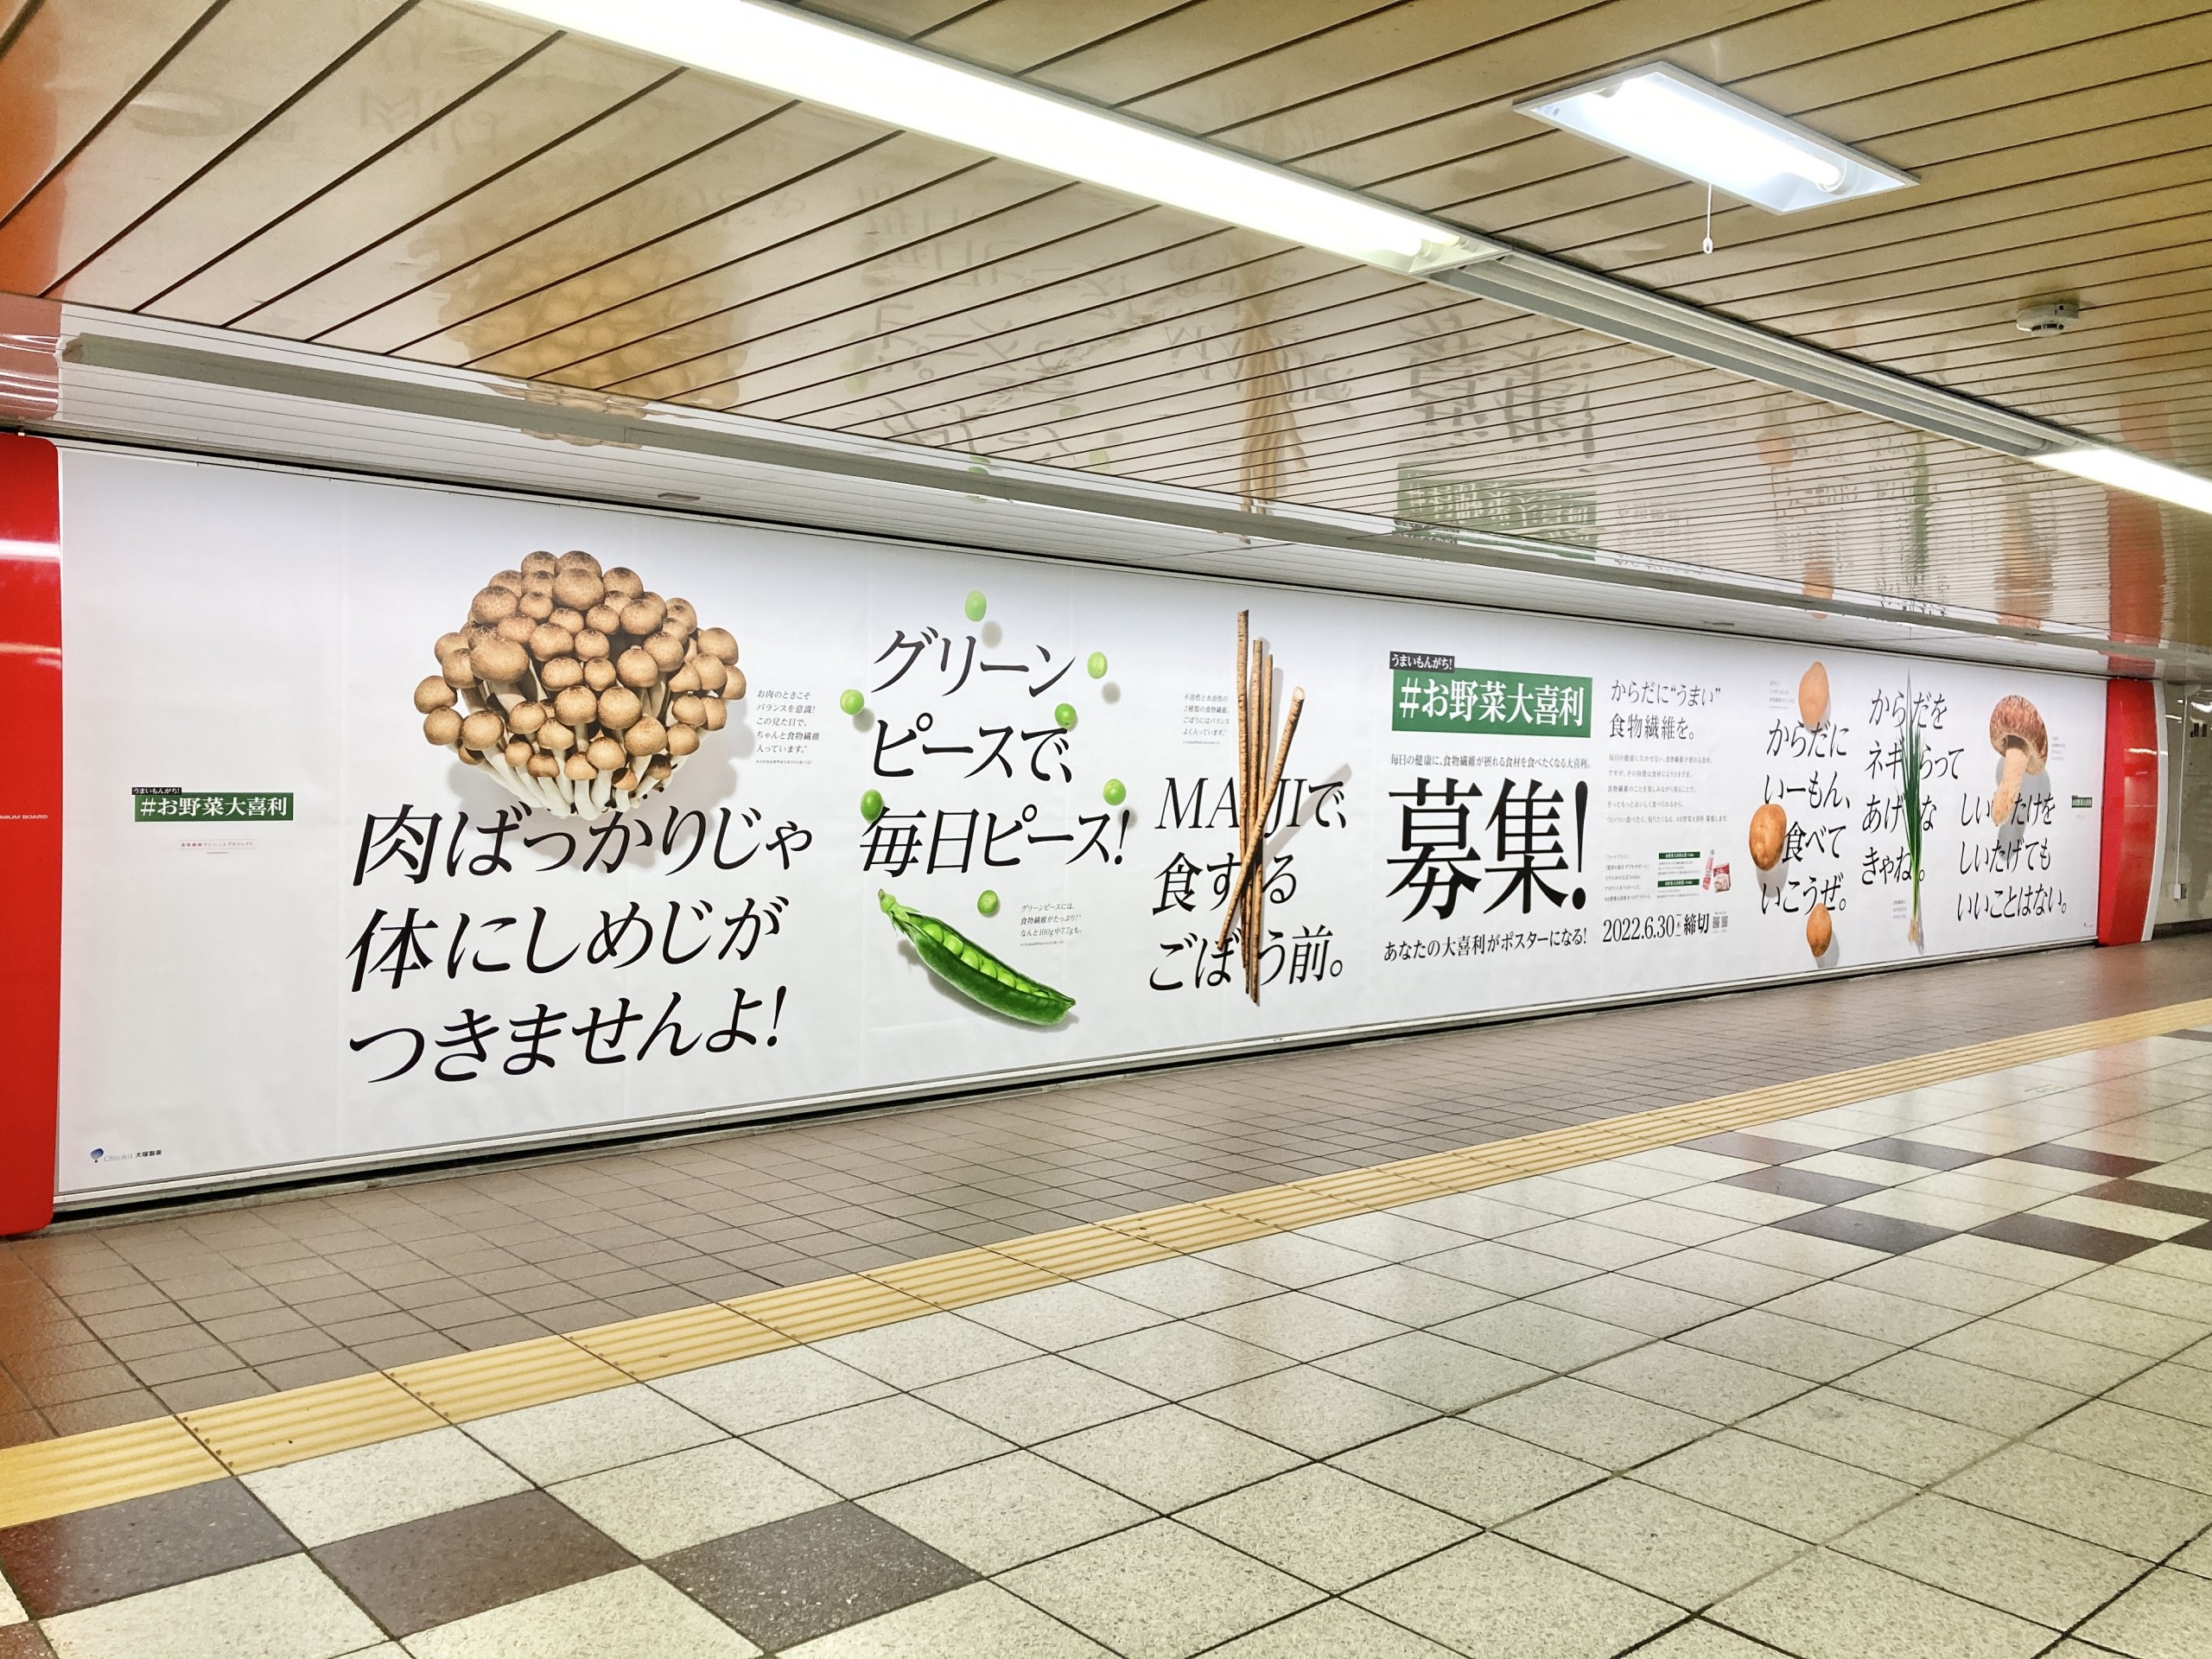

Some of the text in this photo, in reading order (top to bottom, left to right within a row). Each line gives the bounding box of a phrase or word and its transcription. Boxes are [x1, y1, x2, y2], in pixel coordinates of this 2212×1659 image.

[871, 626, 1077, 697] グリーン
[1392, 654, 1452, 671] うまいもんがち!
[757, 690, 811, 700] お肉のときこそ
[1399, 677, 1585, 727] #お野菜大喜利
[1869, 689, 1948, 729] からだを
[757, 731, 820, 741] ちゃんと食物繊維
[1610, 713, 1694, 740] 食物繊維を。
[1766, 718, 1850, 758] からだに
[874, 713, 1072, 784] ピースで、
[140, 797, 288, 817] #お野菜大喜利
[1764, 771, 1851, 808] いーもん、
[1961, 792, 2056, 826] しいたけを
[353, 800, 813, 887] 肉ばっかりじゃ
[860, 804, 1131, 877] 毎日ピース!
[1386, 777, 1588, 922] 募集!
[1782, 821, 1847, 863] 食べて
[1960, 837, 2051, 874] しいたげても
[1153, 852, 1297, 916] 食する
[1862, 846, 1925, 885] きゃね。
[1762, 872, 1847, 915] いこうぜ。
[1957, 884, 2067, 921] いいことはない。
[346, 895, 790, 993] 体にしめじが
[1150, 925, 1343, 991] ごぼう前。
[1383, 927, 1587, 962] あなたの大喜利がポスターになる!
[348, 985, 788, 1084] つきませんよ!
